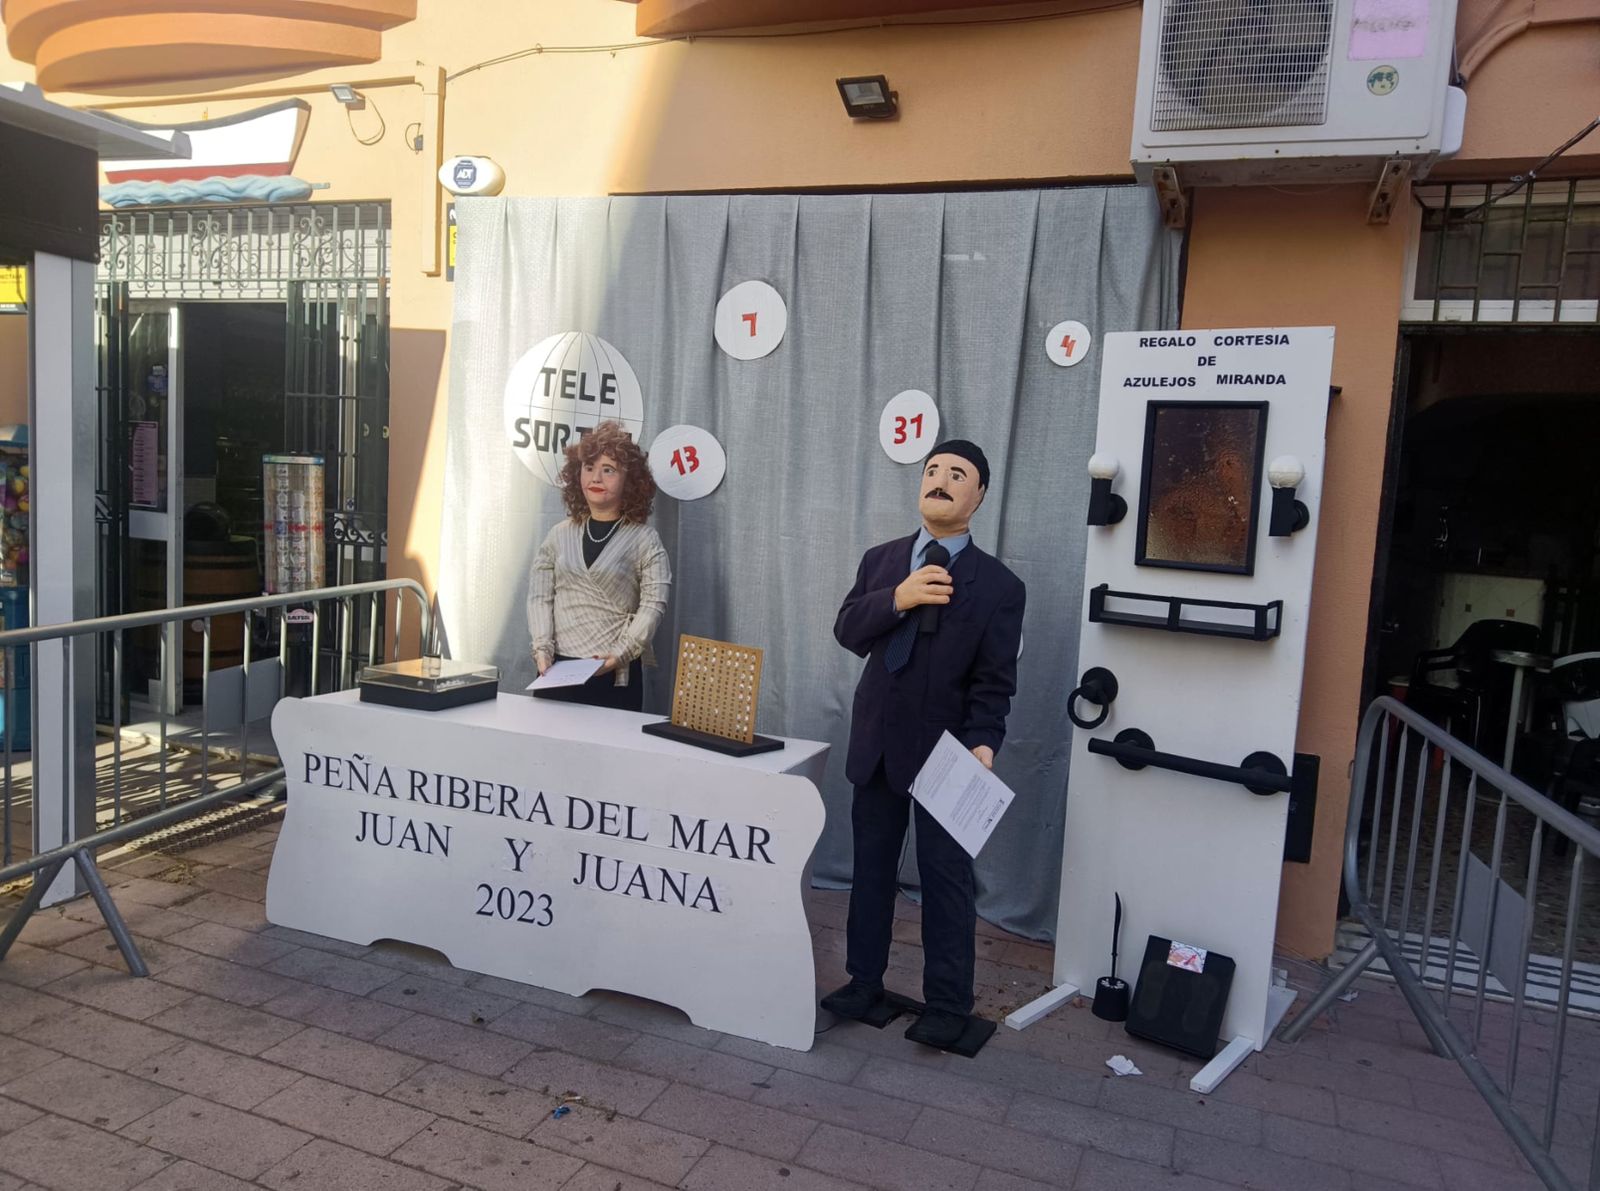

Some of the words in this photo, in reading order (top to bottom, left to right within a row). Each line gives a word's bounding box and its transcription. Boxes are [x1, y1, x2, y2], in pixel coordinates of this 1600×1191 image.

[457, 168, 474, 180] ADT
[742, 312, 757, 337] 7
[1139, 336, 1196, 348] REGALO
[1214, 334, 1290, 347] CORTESIA
[1197, 356, 1217, 367] DE
[540, 366, 617, 406] TELE
[1123, 377, 1197, 388] AZULEJOS
[1216, 374, 1287, 386] MIRANDA
[893, 412, 924, 445] 31
[670, 446, 700, 476] 13
[303, 752, 400, 799] PEÑA
[407, 768, 555, 826] RIBERA
[565, 794, 649, 842] DEL
[667, 813, 776, 865] MAR
[355, 810, 453, 858] JUAN
[504, 837, 534, 872] Y
[572, 851, 723, 914] JUANA
[475, 883, 555, 928] 2023
